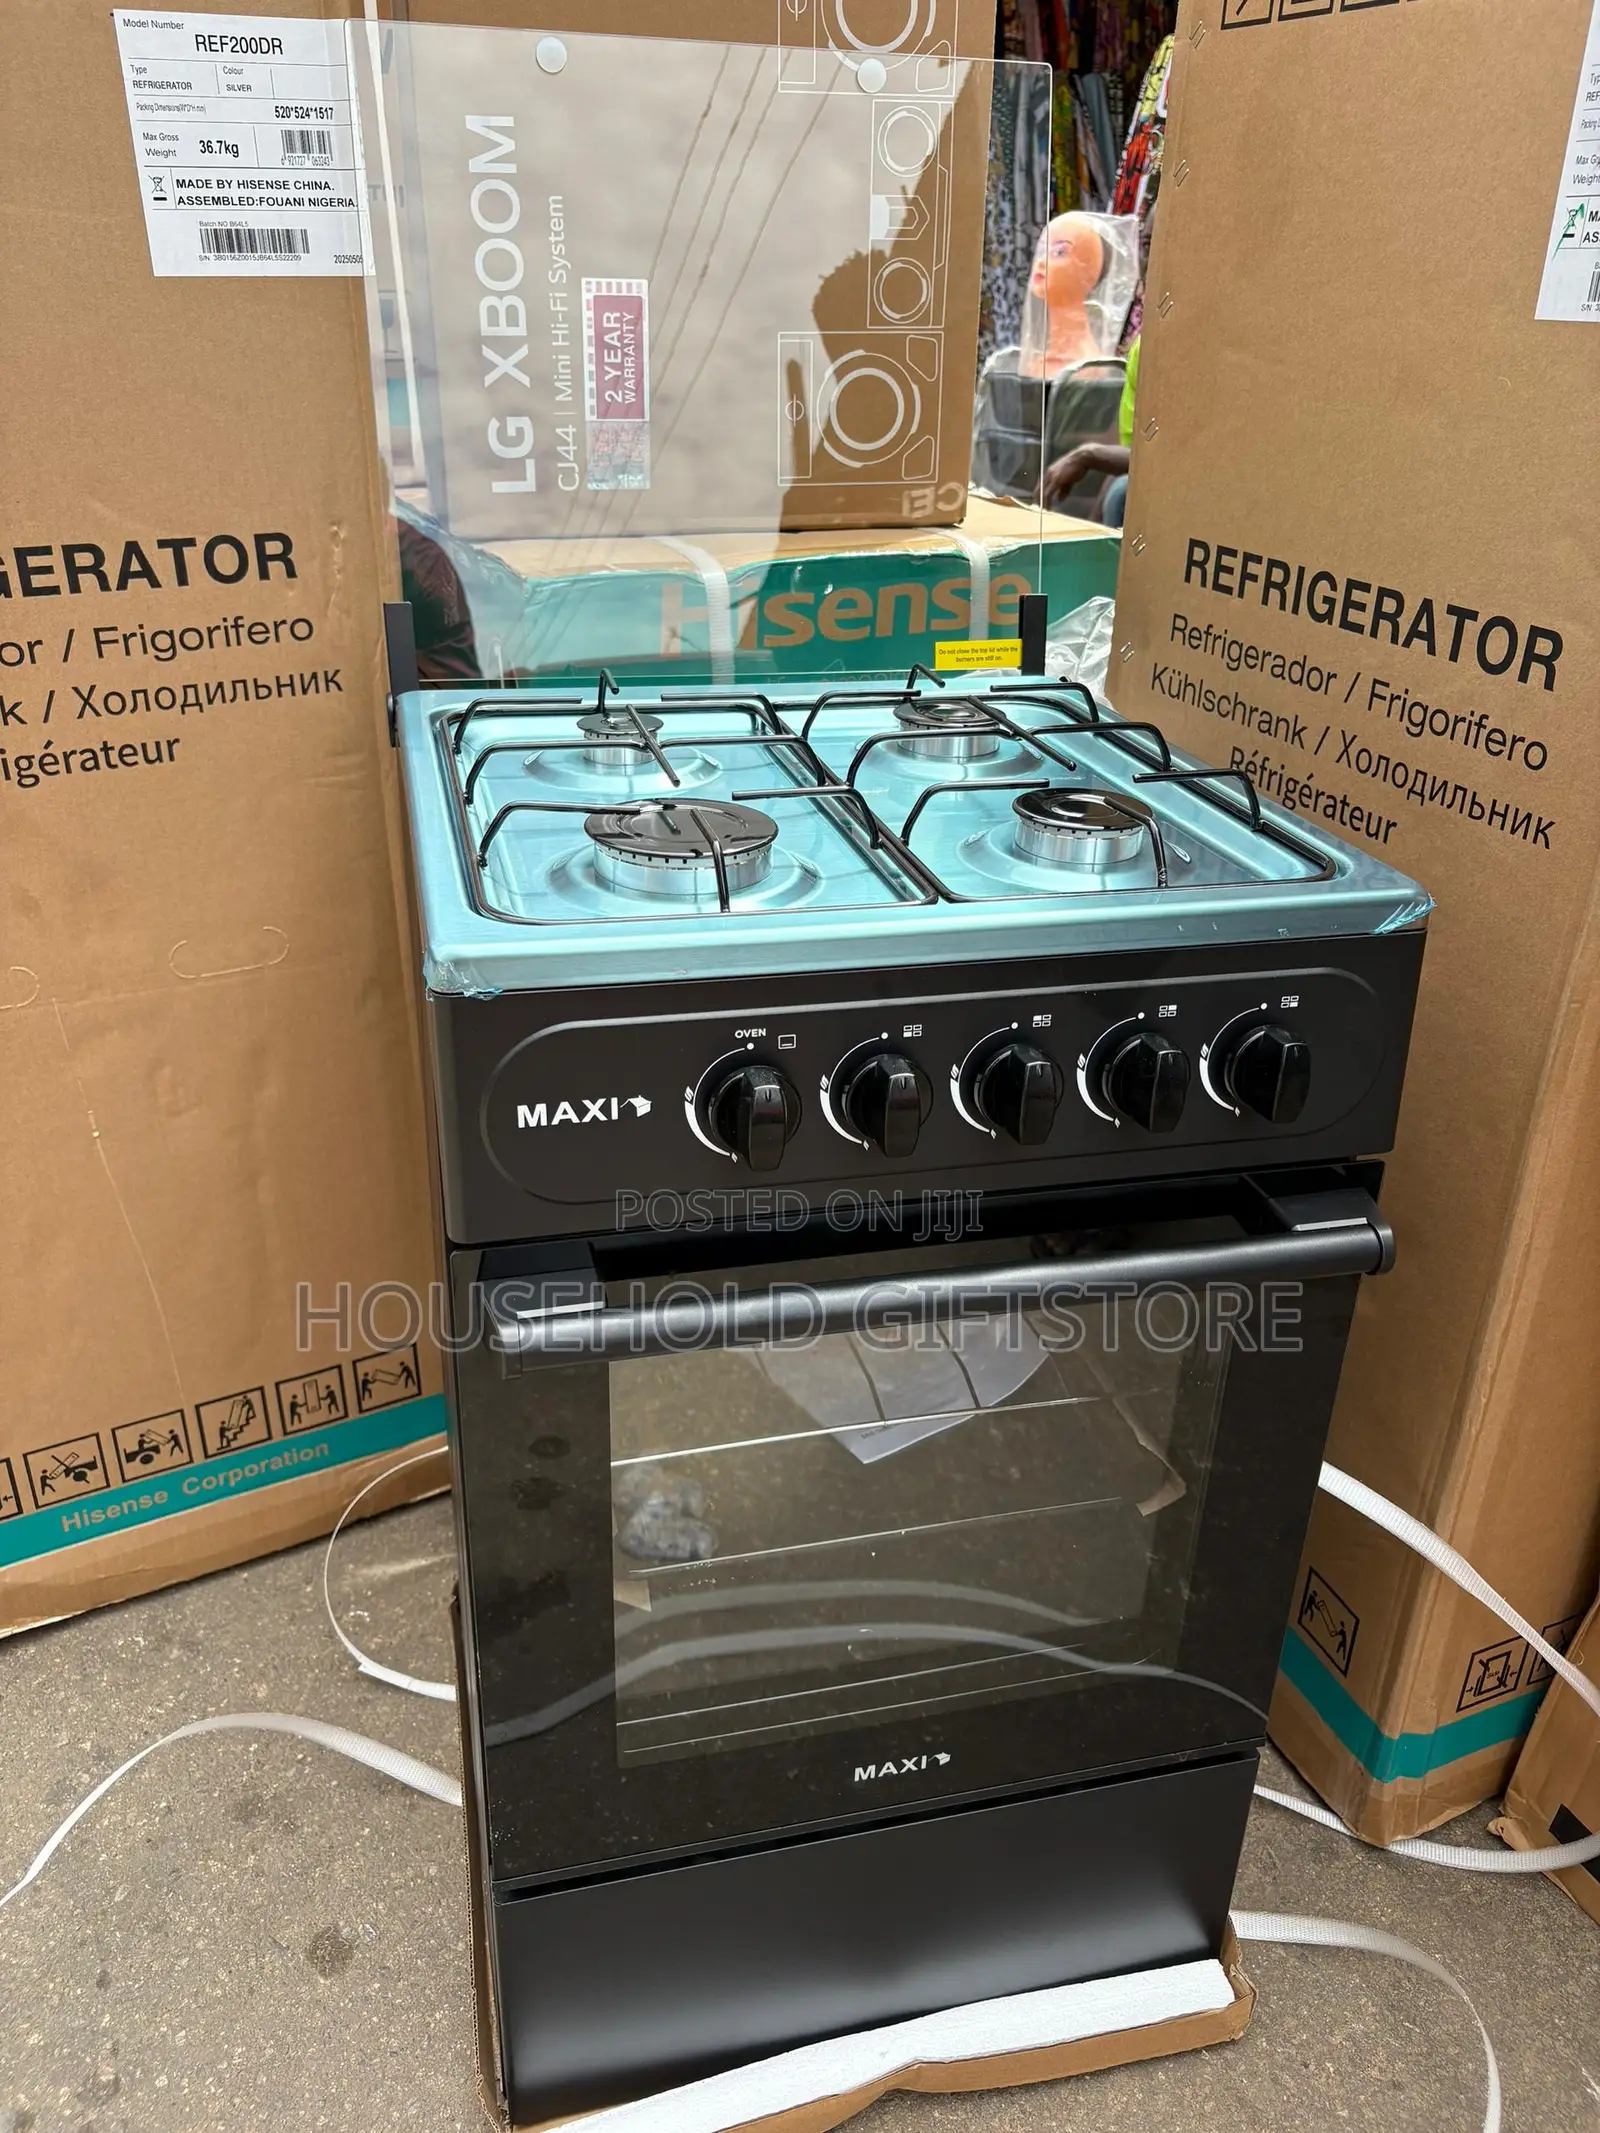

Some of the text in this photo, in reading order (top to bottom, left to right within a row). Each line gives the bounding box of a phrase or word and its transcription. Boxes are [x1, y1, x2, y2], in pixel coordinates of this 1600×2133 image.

[123, 18, 185, 30] Model Number
[194, 34, 284, 55] REF200DR
[130, 64, 148, 75] Type
[132, 80, 193, 91] REFRIGERATOR
[222, 65, 244, 75] Colour
[226, 84, 253, 93] SILVER
[142, 132, 180, 142] Max Gross
[145, 147, 177, 158] Weight
[199, 140, 240, 158] 36.7kg
[176, 178, 335, 191] MADE BY HISENSE CHINA.
[177, 196, 359, 208] ASSEMBLED:FOUANI NIGERIA.
[548, 194, 572, 284] System
[464, 113, 538, 494] LG XBOOM
[550, 291, 570, 346] Hi-Fi
[553, 351, 573, 402] Mini
[603, 311, 622, 404] 2 YEAR
[622, 311, 636, 405] WARRANTY
[557, 423, 580, 492] CJ44
[93, 615, 314, 662] Frigorifero
[1183, 537, 1564, 693] REFRIGERATOR
[71, 668, 344, 720] Холодильник
[1151, 662, 1309, 751] Kühlschrank
[1170, 612, 1338, 696] Refrigerador
[1367, 677, 1549, 772] Frigorifero
[1229, 745, 1398, 845] Réfrigérateur
[1335, 728, 1557, 851] Холодильник
[734, 1027, 767, 1040] OVEN
[516, 1096, 619, 1130] MAXI
[61, 1440, 330, 1534] Hisense Corporation
[854, 1754, 928, 1783] MAXI
